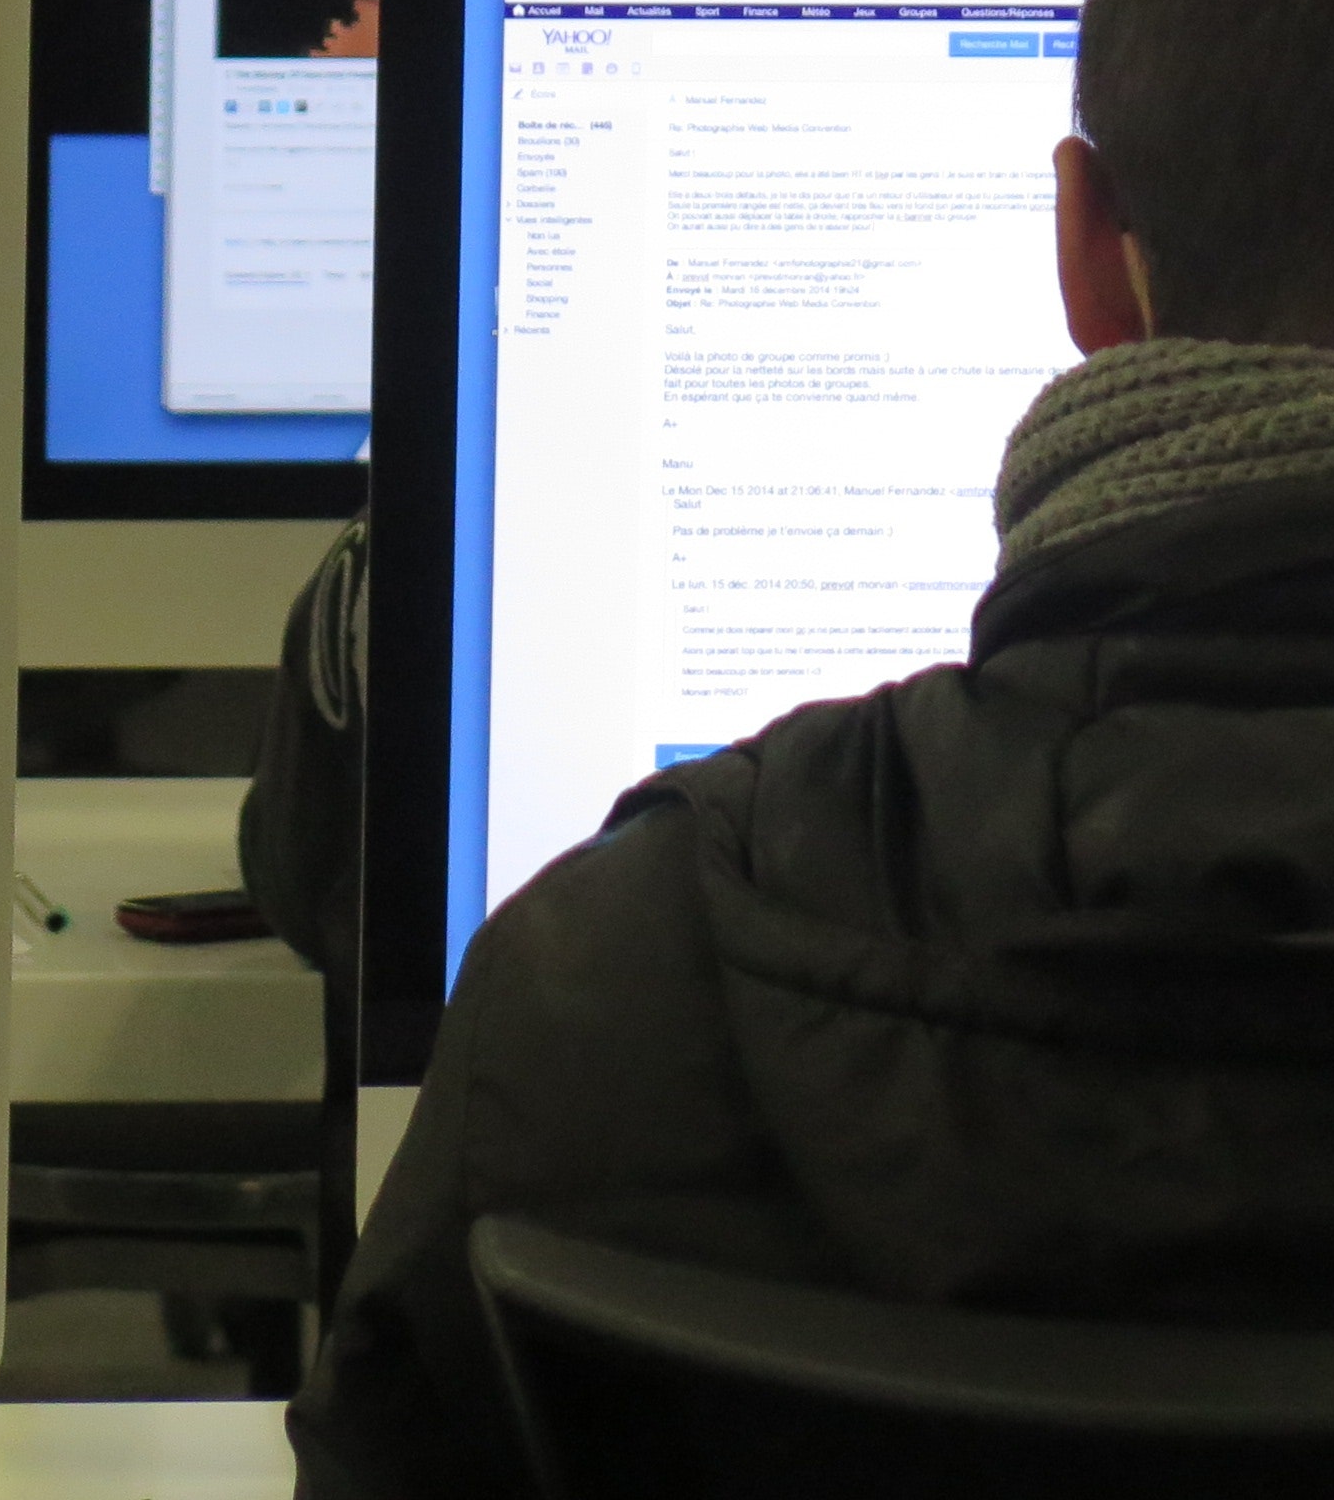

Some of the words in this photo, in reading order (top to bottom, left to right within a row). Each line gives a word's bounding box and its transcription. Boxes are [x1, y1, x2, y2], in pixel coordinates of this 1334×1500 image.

[528, 6, 562, 16] Accueil
[584, 6, 604, 16] Mail
[627, 5, 672, 16] Actualités
[695, 6, 720, 18] Sport
[743, 6, 779, 17] Finance
[801, 6, 831, 17] Météo
[853, 7, 876, 17] Jeux
[899, 7, 938, 19] Groupes
[961, 6, 1055, 19] Questions/Réponses
[542, 28, 612, 46] YAHOO!
[664, 351, 691, 362] Voilà
[694, 351, 705, 362] la
[707, 351, 739, 364] photo
[741, 351, 755, 362] de
[758, 353, 796, 364] groupe
[798, 354, 840, 362] comme
[843, 352, 881, 364] promis
[664, 365, 702, 376] Désolé
[705, 367, 730, 378] pour
[732, 365, 742, 376] la
[745, 365, 783, 376] netteté
[787, 368, 804, 376] sur
[806, 365, 822, 376] les
[825, 365, 856, 376] bords
[859, 365, 885, 376] mais
[889, 366, 915, 376] suite
[928, 368, 948, 376] une
[951, 366, 982, 376] chute
[985, 366, 995, 376] la
[998, 367, 1045, 376] semaine
[664, 379, 681, 389] fait
[684, 381, 709, 392] pour
[711, 379, 746, 389] toutes
[749, 379, 765, 389] les
[768, 379, 805, 391] photos
[808, 379, 821, 389] de
[824, 380, 871, 391] groupes.
[664, 392, 678, 402] En
[681, 392, 729, 404] espérant
[732, 394, 752, 404] que
[755, 394, 769, 405] ça
[772, 392, 783, 402] te
[785, 393, 843, 402] convienne
[845, 392, 880, 404] quand
[662, 458, 694, 469] Manu
[662, 485, 675, 496] Le
[678, 485, 702, 496] Mon
[705, 485, 727, 496] Dec
[731, 485, 744, 496] 15
[747, 485, 775, 496] 2014
[777, 485, 788, 496] at
[844, 485, 885, 496] Manuel
[888, 486, 946, 497] Fernandez
[673, 499, 702, 510] Salut
[672, 525, 693, 536] Pas
[696, 525, 710, 536] de
[712, 525, 765, 538] problème
[767, 526, 777, 538] je
[826, 528, 840, 539] ça
[843, 526, 884, 536] demain
[671, 579, 685, 590] Le
[712, 579, 724, 590] 15
[754, 579, 781, 590] 2014
[858, 581, 898, 590] morvan
